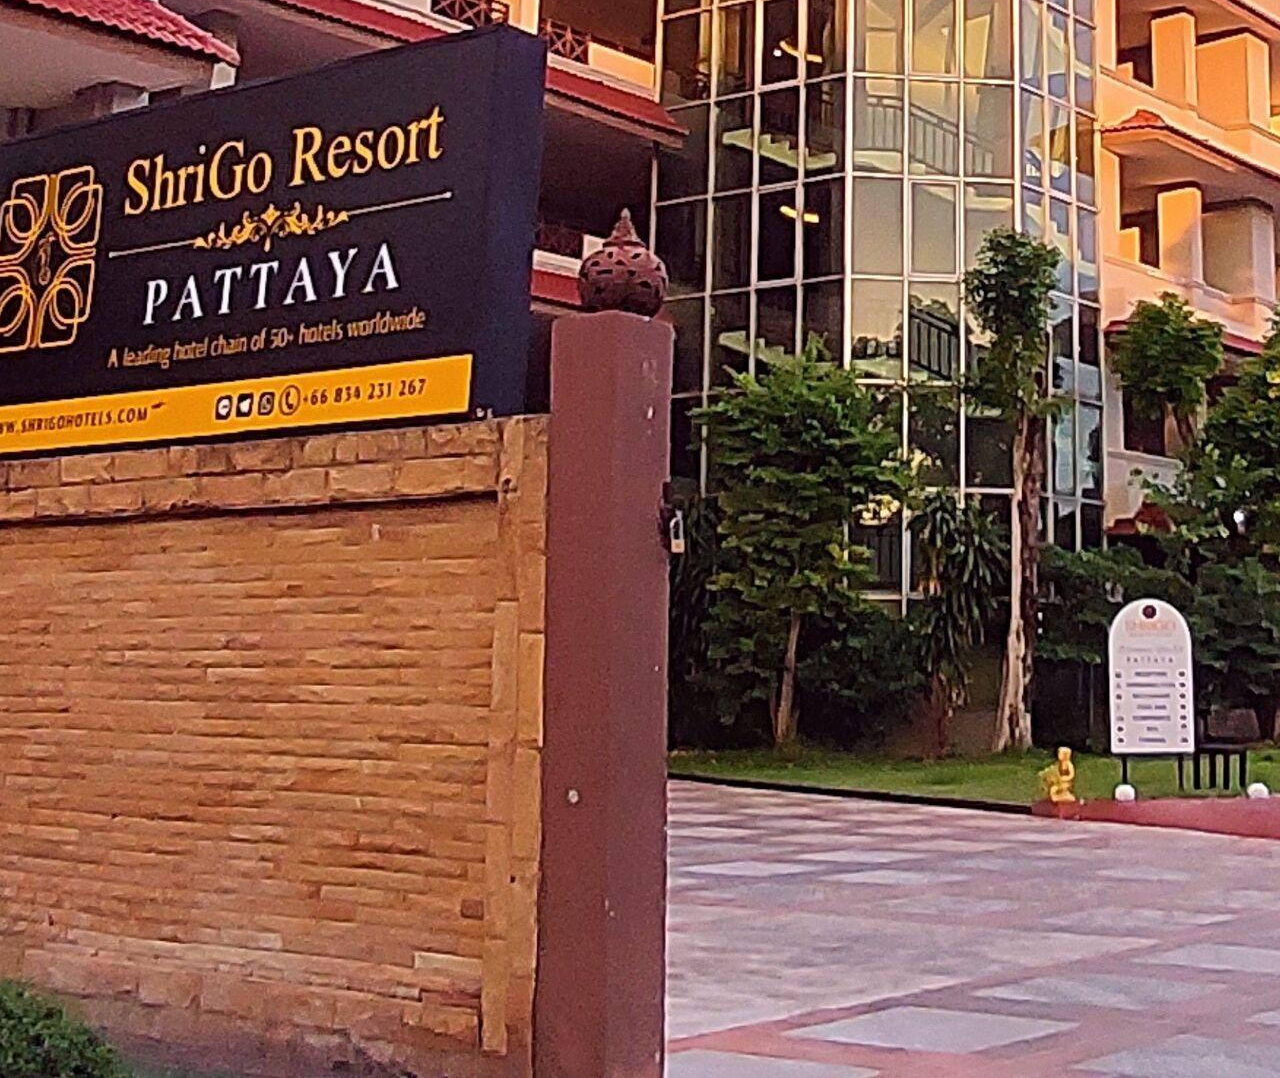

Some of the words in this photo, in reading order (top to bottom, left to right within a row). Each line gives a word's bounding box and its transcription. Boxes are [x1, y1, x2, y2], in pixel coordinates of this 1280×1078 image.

[124, 139, 273, 215] ShriGo
[288, 105, 444, 187] Resort
[142, 242, 399, 325] PATTAYA
[107, 348, 118, 368] A
[122, 343, 170, 369] leading
[173, 337, 208, 361] hotel
[210, 333, 247, 356] chain
[251, 328, 267, 352] of
[269, 329, 294, 349] 50+
[298, 322, 343, 344] hotels
[347, 306, 426, 338] worldwide
[334, 385, 361, 403] 834
[367, 381, 392, 400] 231
[398, 378, 426, 396] 267
